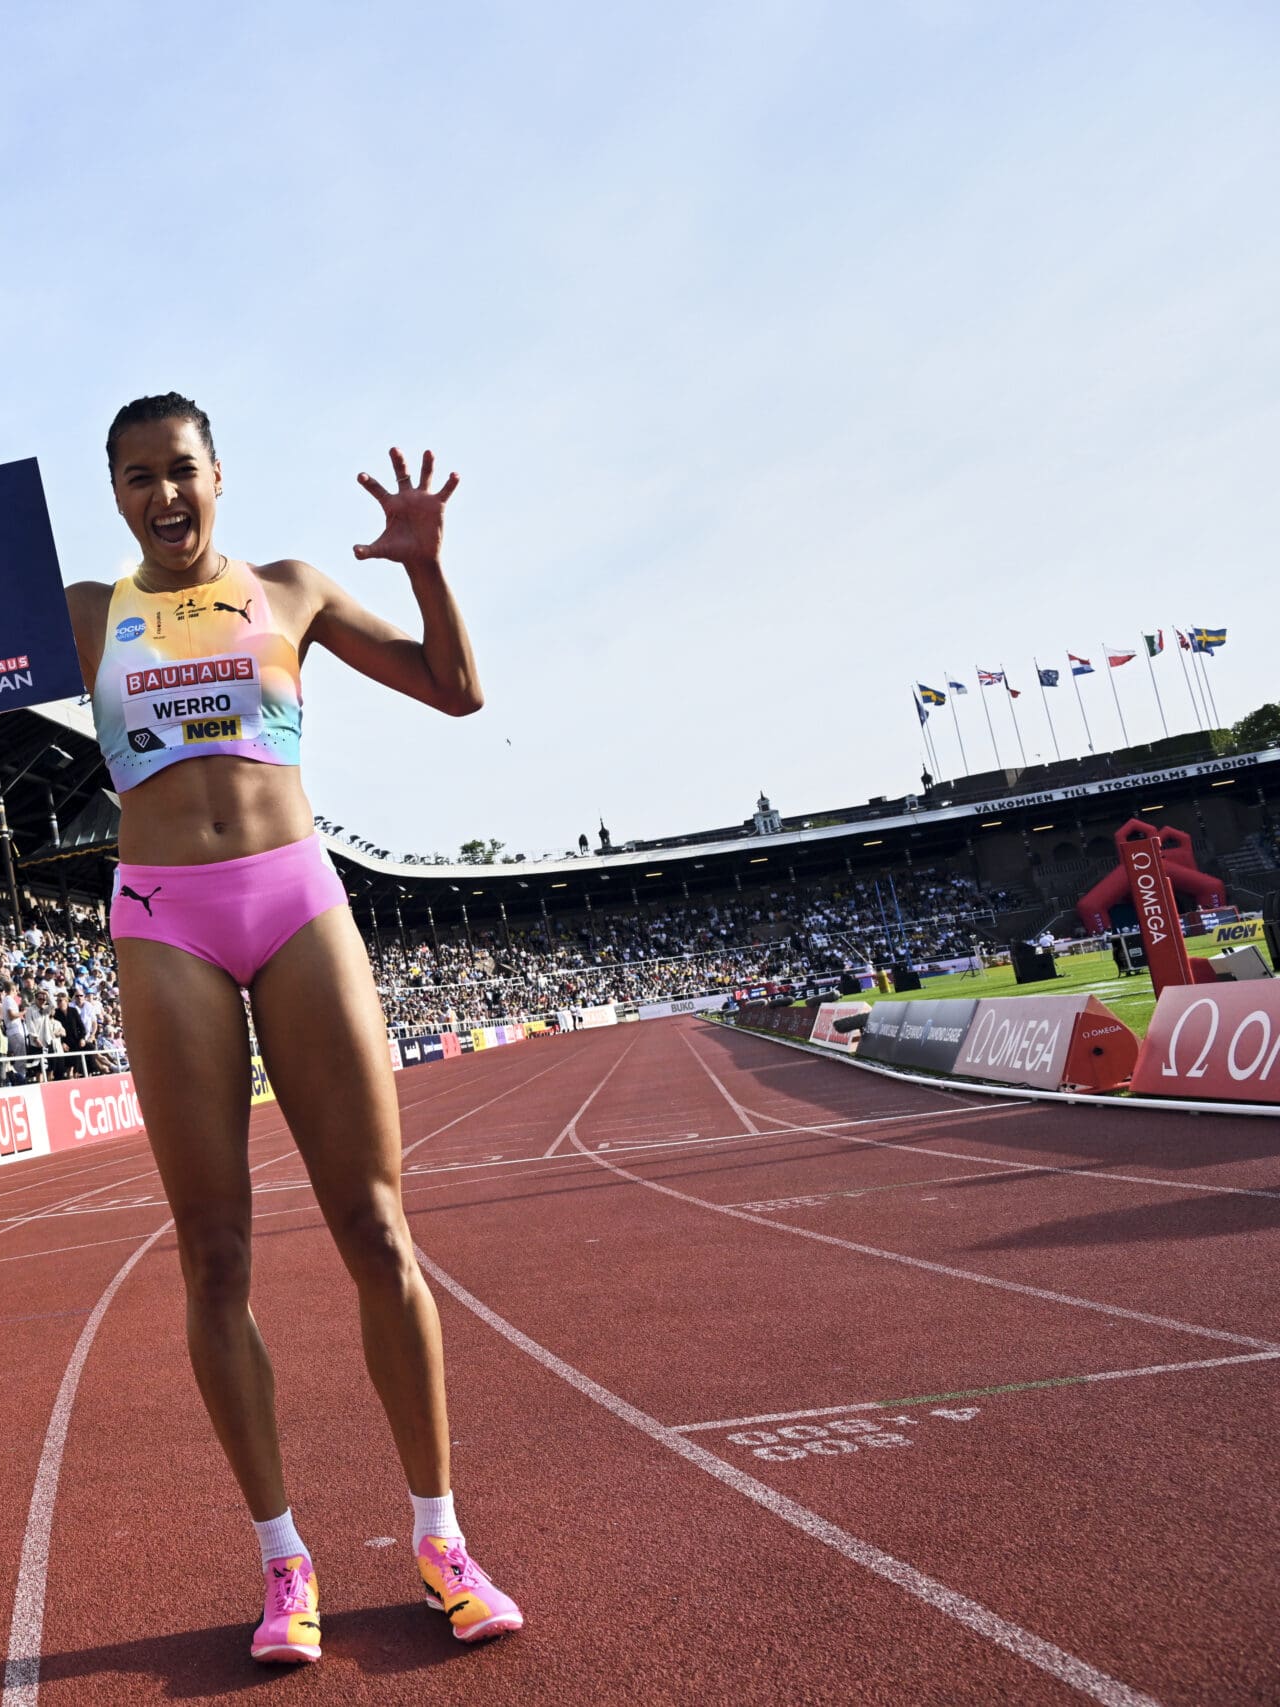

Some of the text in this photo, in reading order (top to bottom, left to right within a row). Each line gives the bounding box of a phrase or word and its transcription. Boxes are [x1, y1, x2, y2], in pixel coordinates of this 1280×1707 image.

[128, 660, 250, 692] BAUHAUS
[153, 694, 231, 719] WERRO
[1061, 788, 1090, 799] TILL
[1098, 769, 1187, 792] STOCKHOLMS
[1196, 755, 1259, 775] STADION
[1138, 874, 1167, 944] OMEGA
[795, 985, 838, 999] ZEEK
[987, 1018, 1062, 1073] OMEGA
[1091, 1024, 1123, 1037] OMEGA
